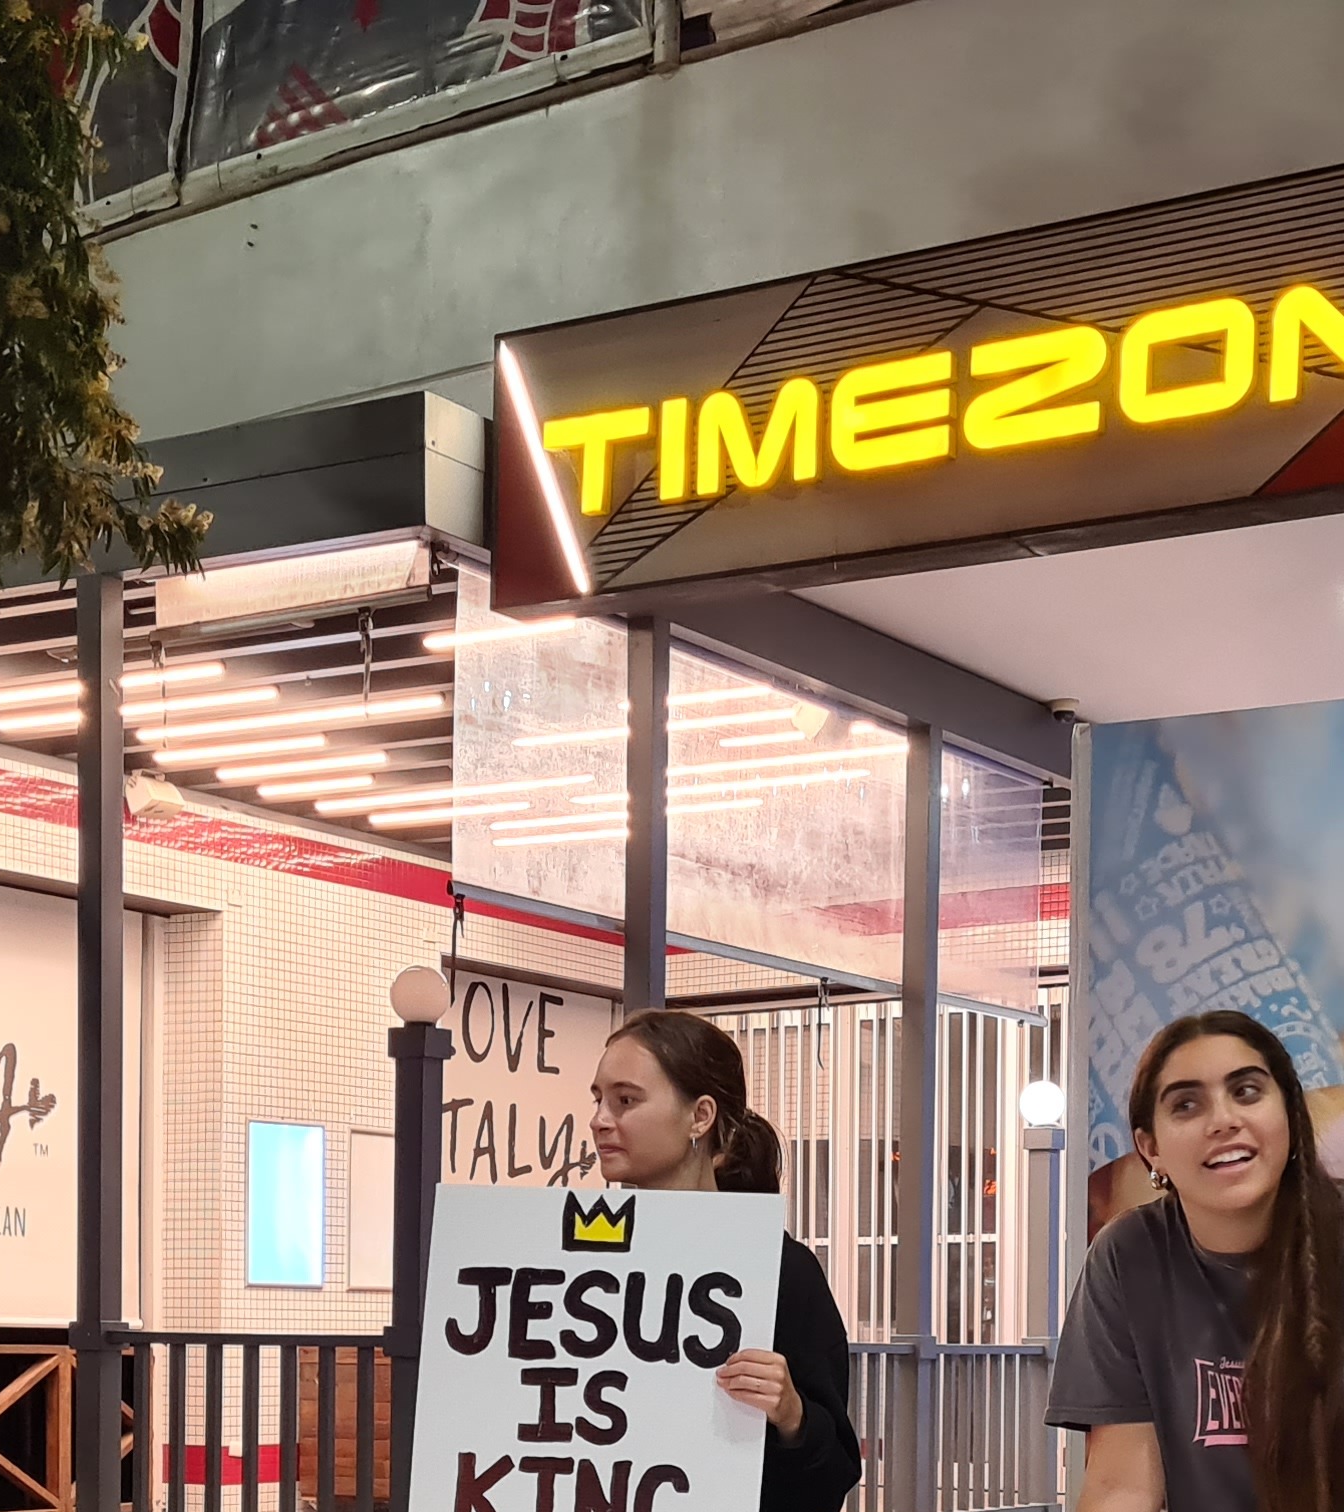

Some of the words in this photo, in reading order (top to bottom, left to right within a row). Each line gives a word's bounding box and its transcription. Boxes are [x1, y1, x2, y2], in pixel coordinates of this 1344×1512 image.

[454, 980, 564, 1075] OVE
[441, 1097, 574, 1187] TALy
[444, 1266, 743, 1369] JESUS
[516, 1366, 630, 1446] IS
